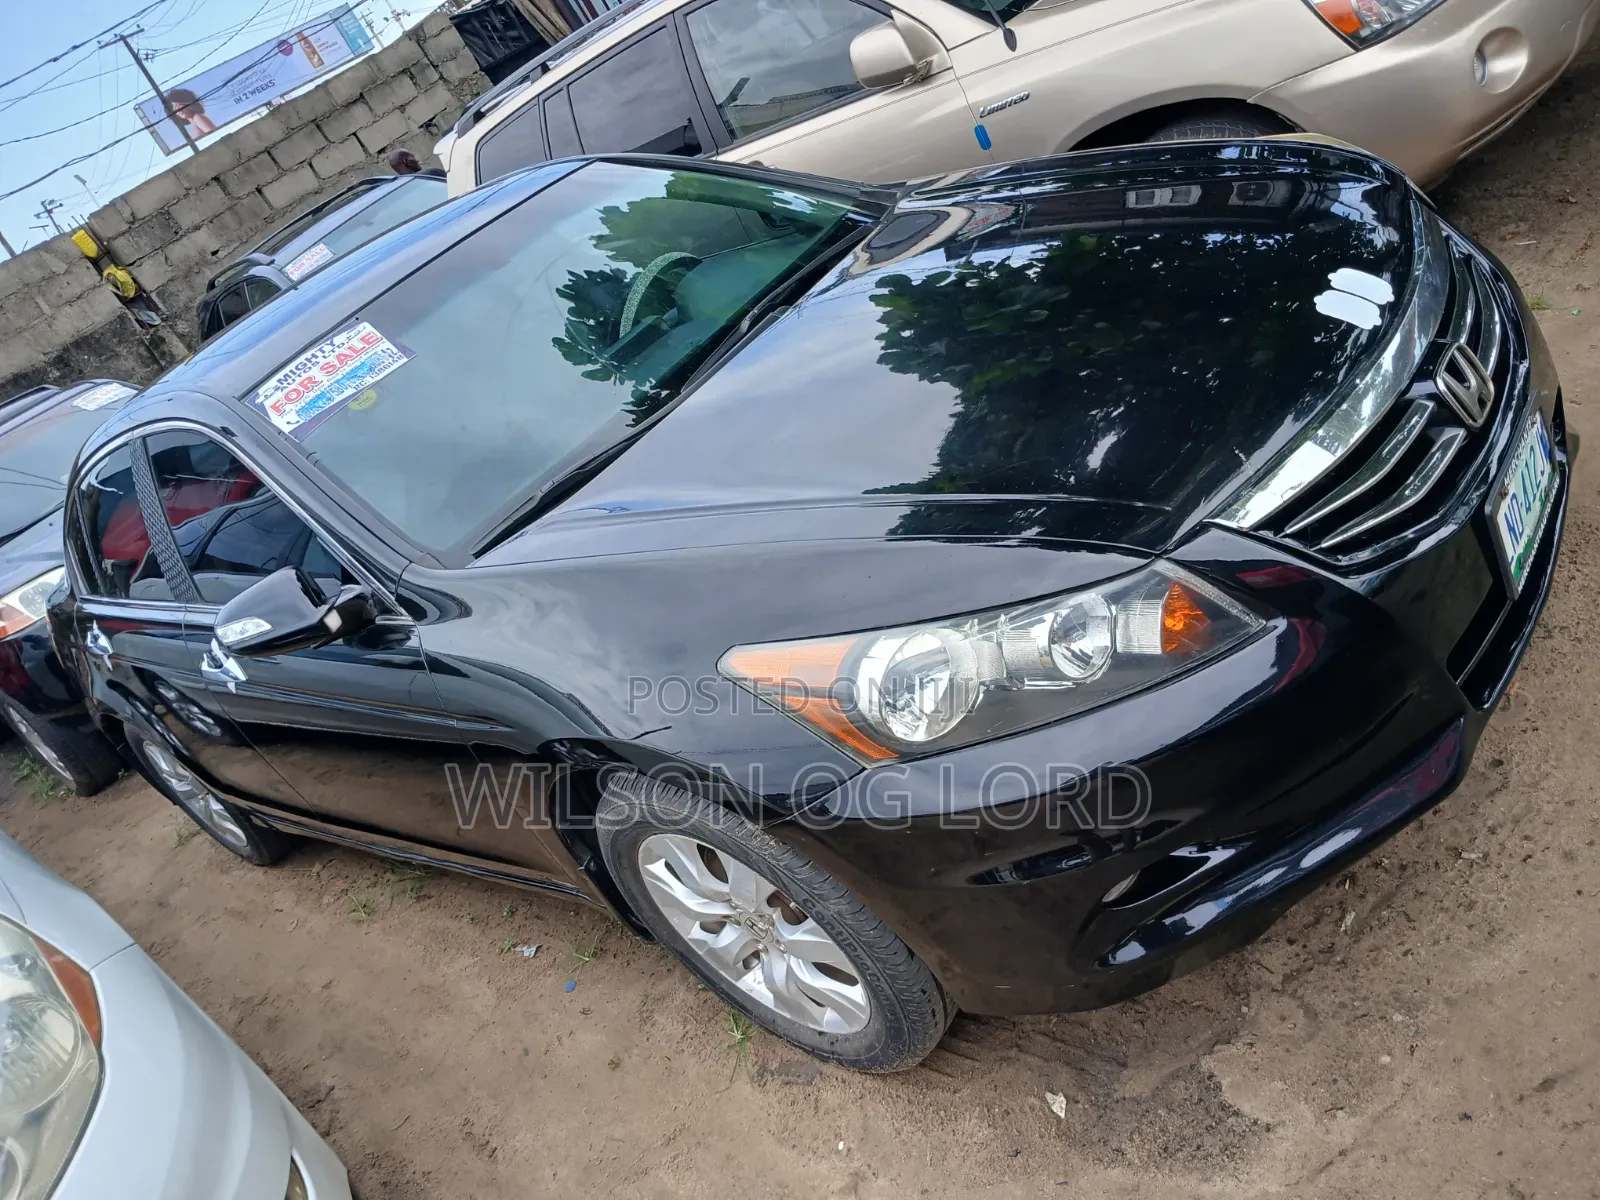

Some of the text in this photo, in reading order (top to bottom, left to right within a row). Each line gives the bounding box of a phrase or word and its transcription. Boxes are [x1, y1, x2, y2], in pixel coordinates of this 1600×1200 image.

[233, 95, 244, 105] IN
[269, 375, 323, 416] FOR
[319, 330, 384, 377] SALE
[276, 338, 336, 386] MIGHTY
[280, 360, 320, 393] AUTOS
